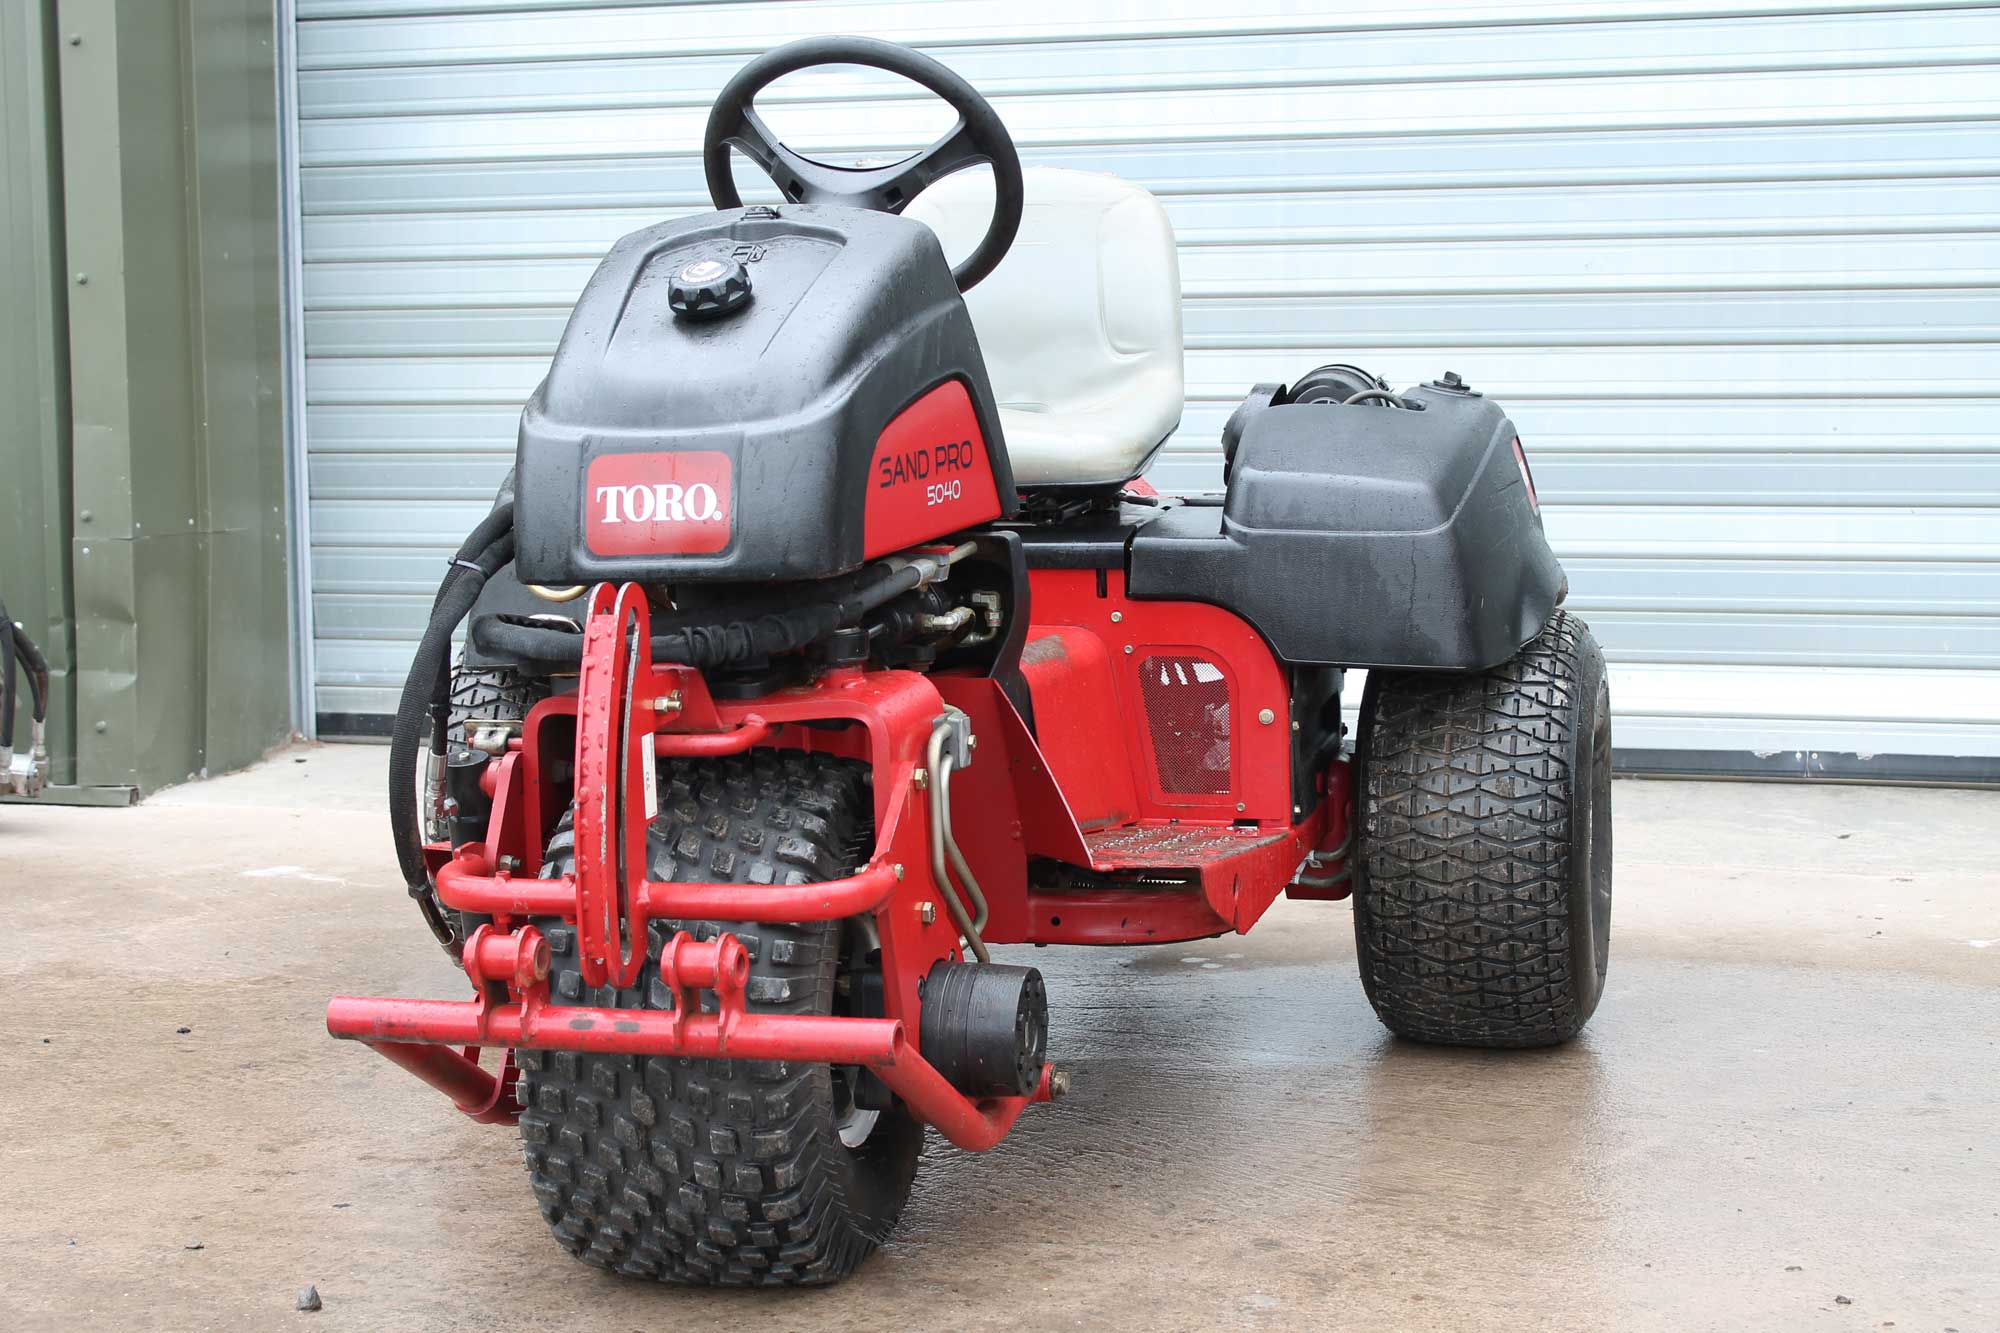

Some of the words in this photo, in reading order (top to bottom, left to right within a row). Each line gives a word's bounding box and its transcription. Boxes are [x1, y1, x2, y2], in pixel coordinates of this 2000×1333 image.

[879, 449, 929, 488] SAND
[935, 440, 973, 475] PRO
[927, 479, 961, 506] 5040
